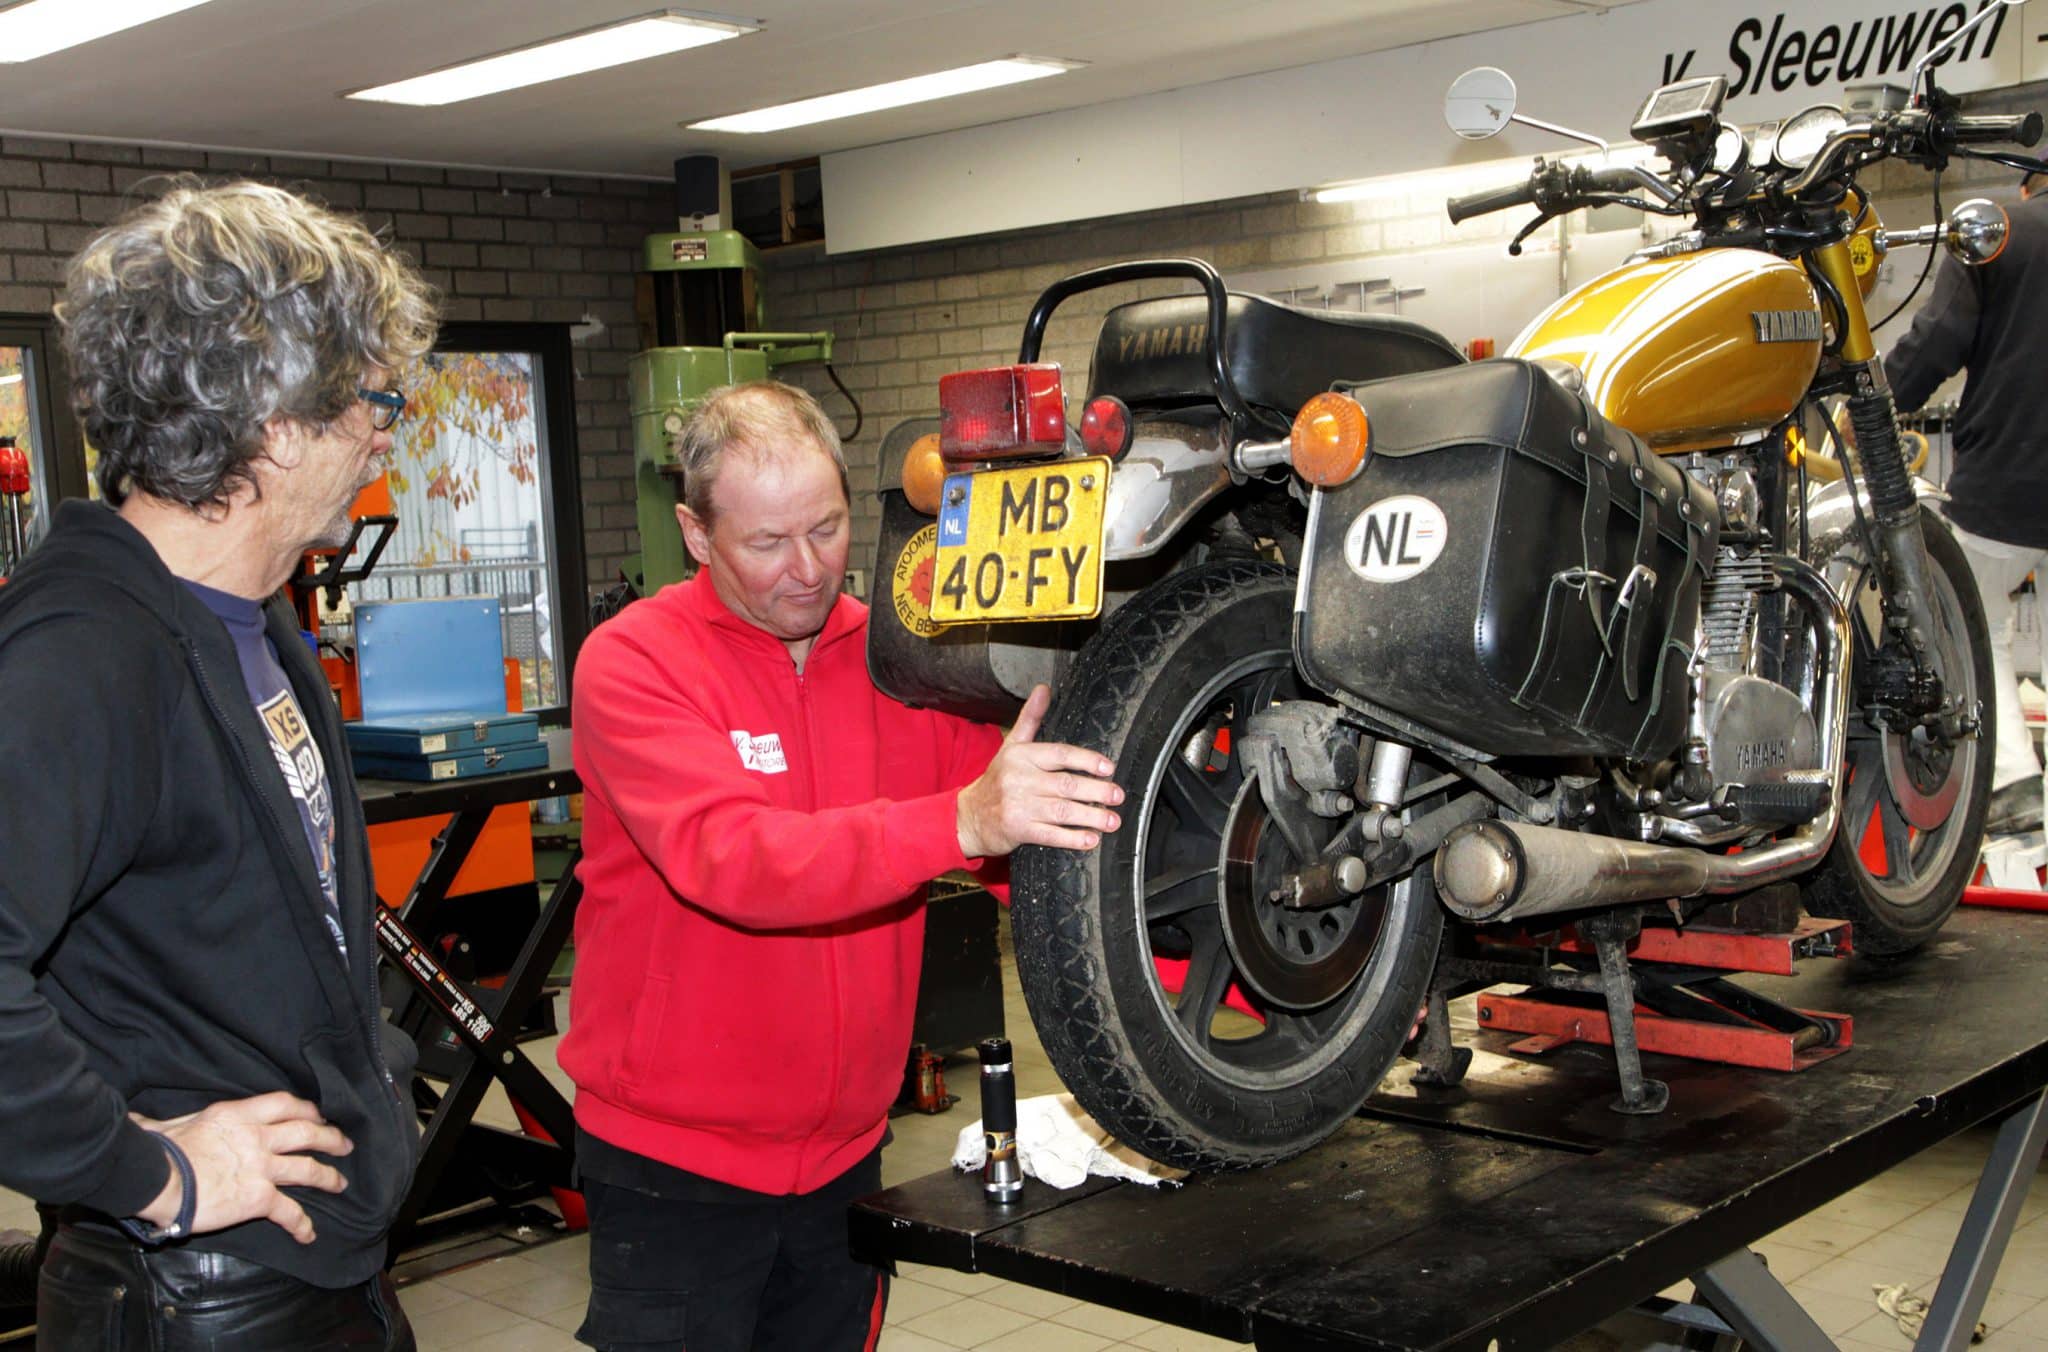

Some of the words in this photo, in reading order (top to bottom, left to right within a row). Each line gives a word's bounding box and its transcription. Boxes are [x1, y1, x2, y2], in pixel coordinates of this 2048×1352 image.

[1726, 0, 2009, 99] Sleeuwen
[1120, 324, 1207, 362] YAMAH
[999, 475, 1070, 536] MB
[944, 519, 962, 535] NL
[1360, 511, 1422, 567] NL
[897, 527, 937, 580] ATOOME
[941, 545, 1088, 611] 40-FY
[896, 593, 915, 626] NEE
[273, 707, 302, 743] XS
[1736, 739, 1785, 770] YAMAHA
[451, 1002, 469, 1022] LBS
[461, 998, 475, 1014] KG
[475, 1014, 493, 1032] 500
